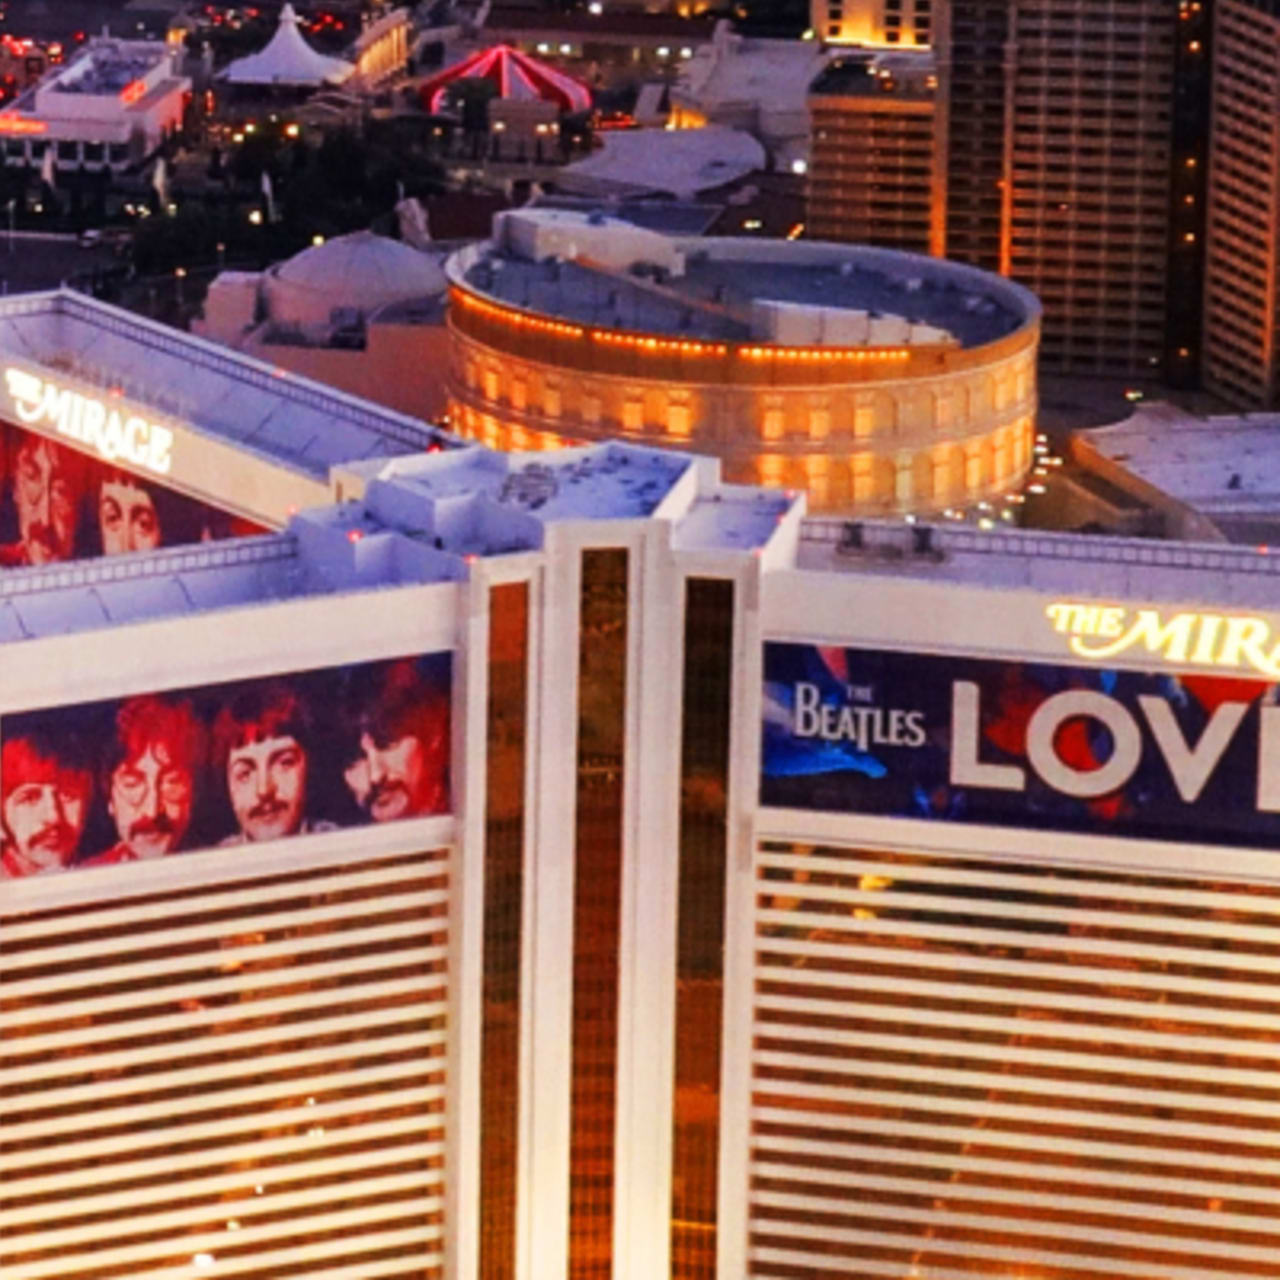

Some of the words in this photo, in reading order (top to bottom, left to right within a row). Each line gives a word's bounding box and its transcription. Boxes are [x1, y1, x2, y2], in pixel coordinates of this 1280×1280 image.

[14, 383, 174, 474] MIRAGE
[1046, 602, 1126, 636] THE
[794, 680, 927, 752] BEATLES
[845, 685, 874, 703] THE
